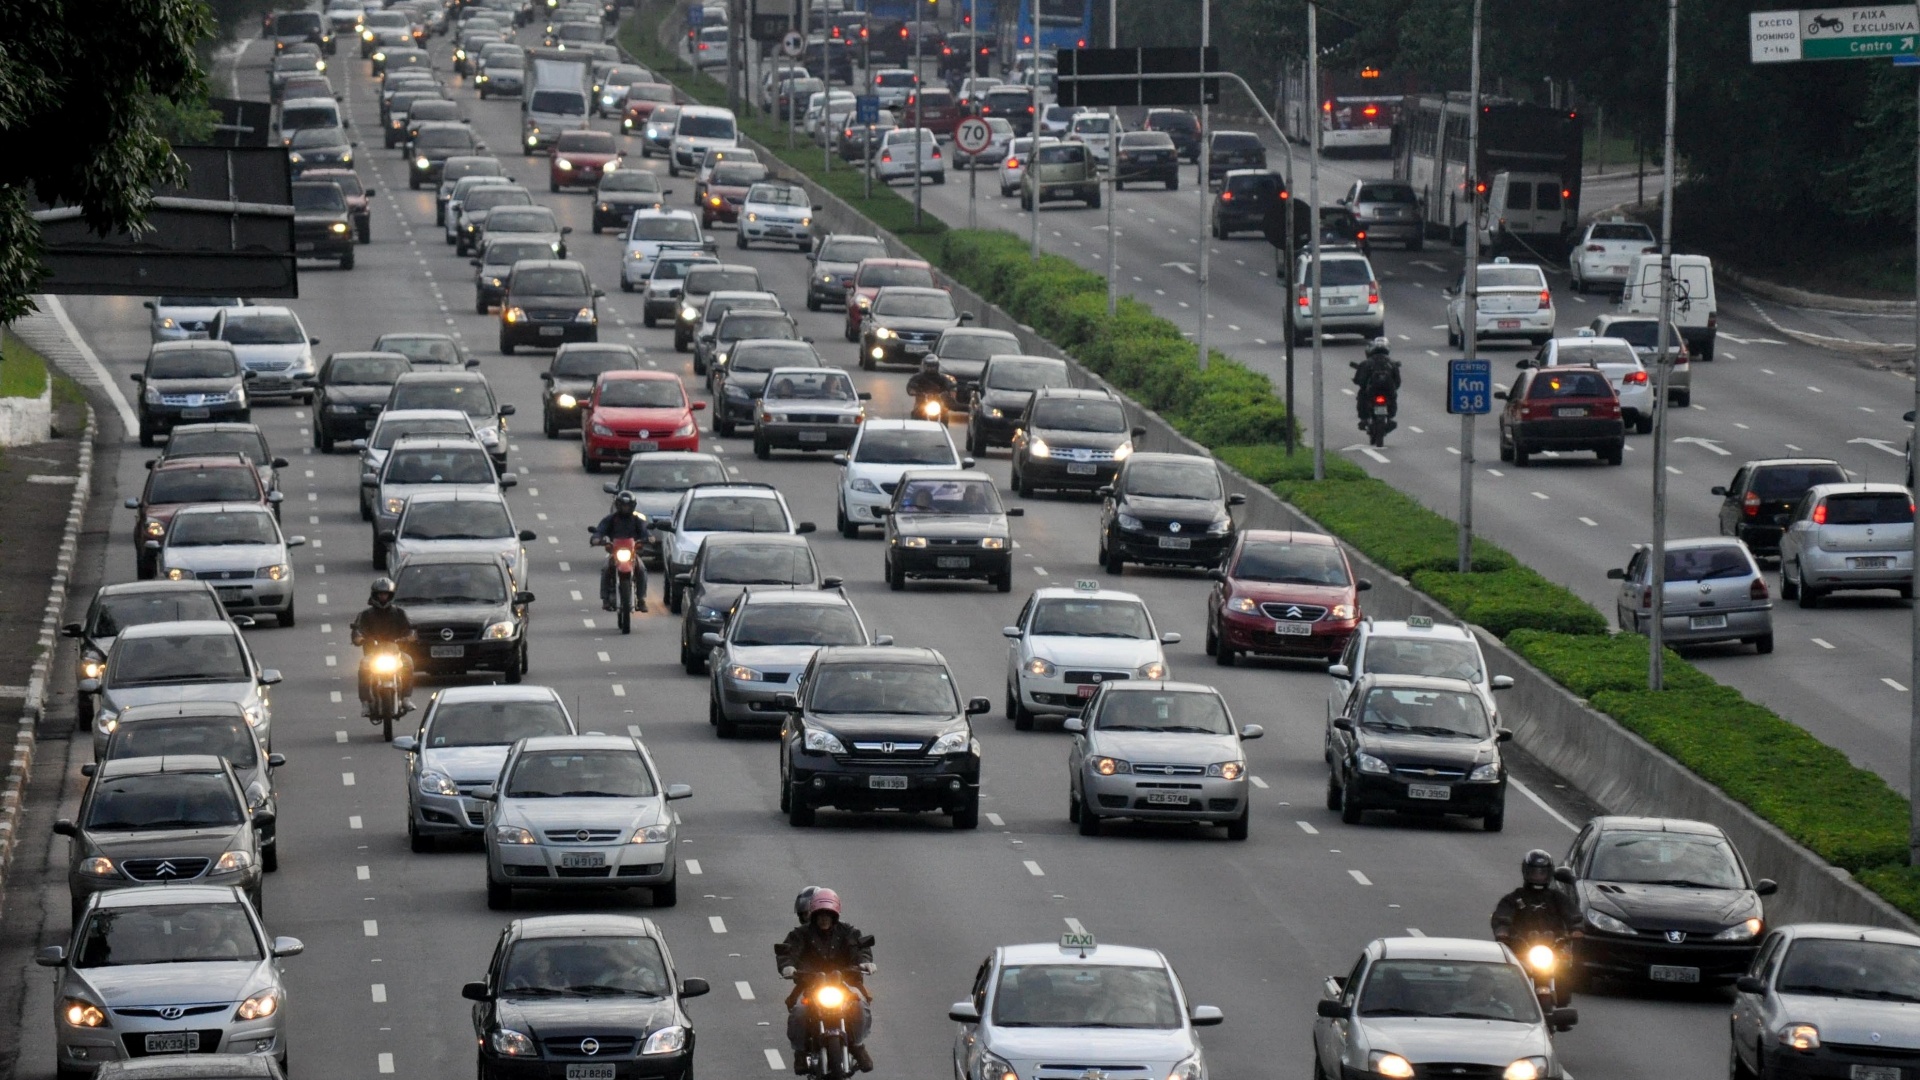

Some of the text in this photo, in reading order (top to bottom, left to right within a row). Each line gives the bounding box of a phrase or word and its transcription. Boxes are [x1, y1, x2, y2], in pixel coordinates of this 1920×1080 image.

[1852, 10, 1886, 20] FAIXA
[1758, 18, 1793, 28] EXCETO
[1853, 21, 1914, 33] EXCLUSIVA
[1756, 32, 1795, 41] DOMINGO
[1850, 41, 1893, 52] Centro
[962, 125, 985, 141] 70
[1455, 363, 1487, 371] CENTRO
[1458, 377, 1485, 392] Km
[1460, 394, 1484, 410] 3,8
[1077, 580, 1097, 589] TAXI
[1411, 616, 1431, 626] TAXI
[1064, 934, 1093, 946] TAXI
